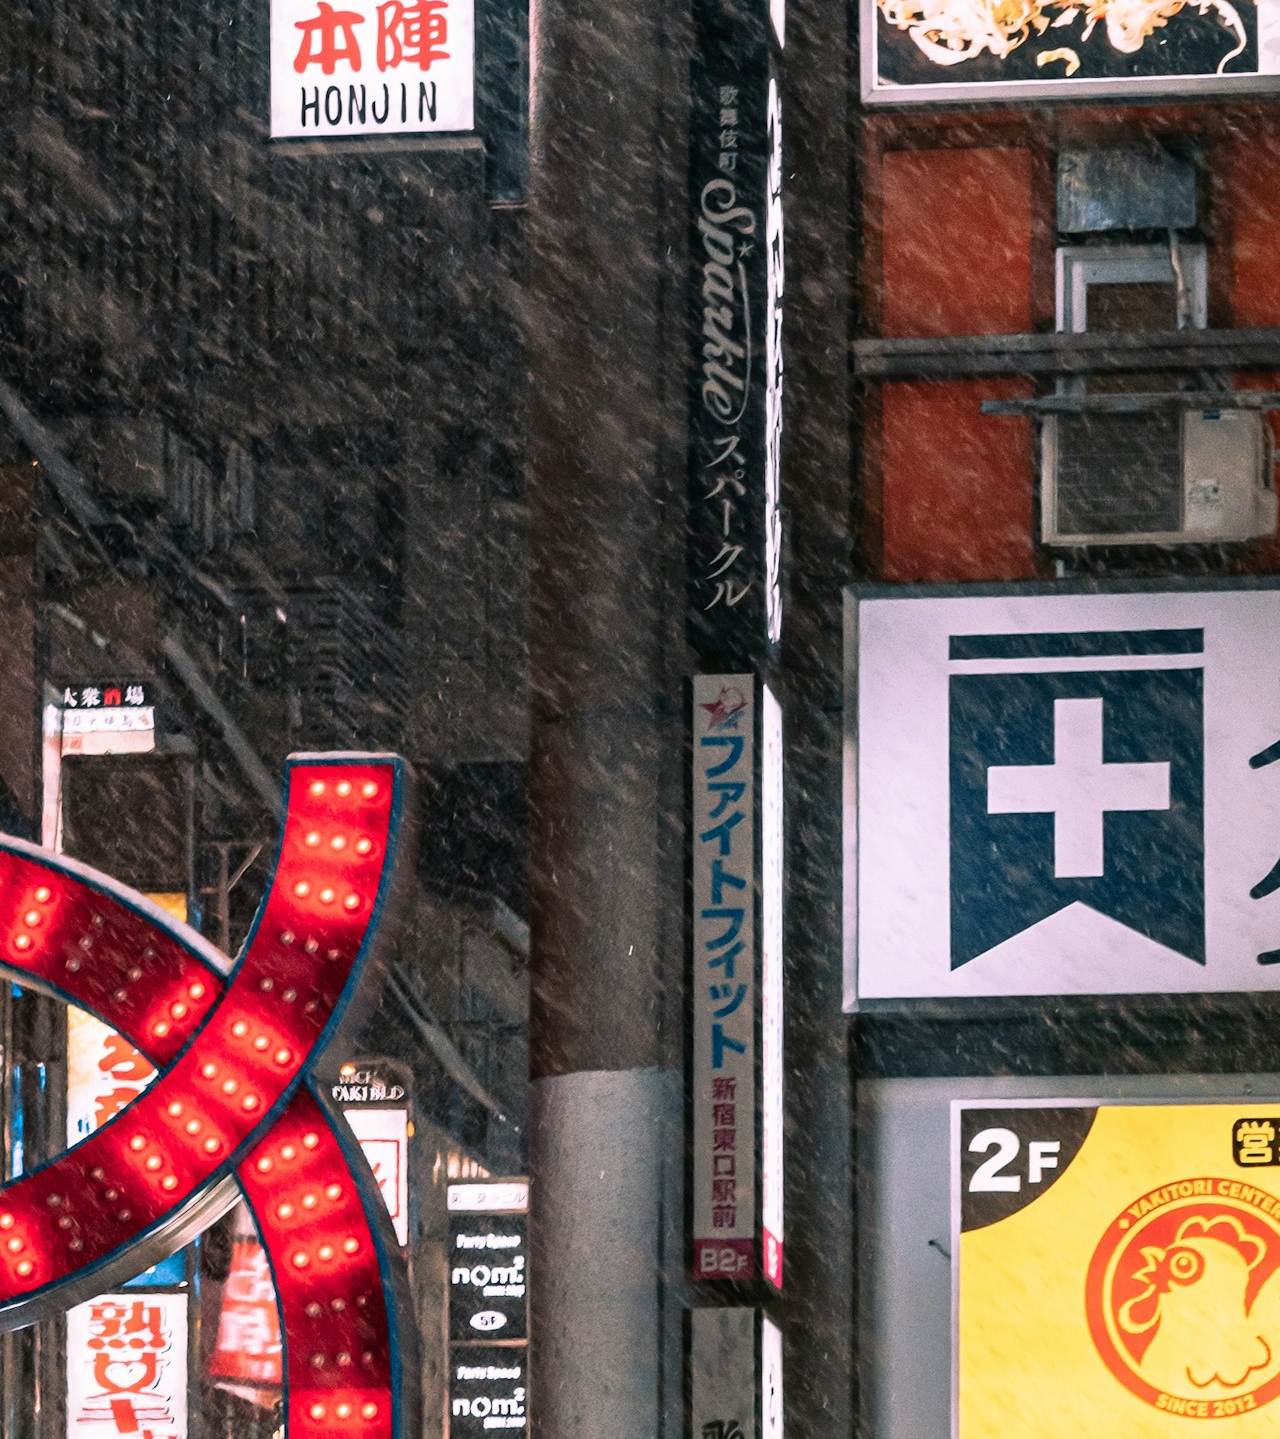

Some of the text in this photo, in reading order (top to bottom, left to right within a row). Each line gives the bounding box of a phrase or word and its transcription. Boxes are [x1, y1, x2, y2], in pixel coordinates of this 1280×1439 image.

[301, 81, 438, 128] HONJIN
[719, 84, 739, 172] 歌舞伎町
[700, 178, 755, 425] Sparkle
[704, 434, 752, 612] スパークル
[699, 734, 748, 1069] ファイトフィット
[710, 1076, 737, 1230] 新宿東口駅前
[968, 1127, 1061, 1193] 2F
[1236, 1120, 1280, 1165] 営
[1127, 1178, 1213, 1221] YAKITORI
[700, 1245, 748, 1272] B2F
[1155, 1393, 1257, 1418] SINCE 2012
